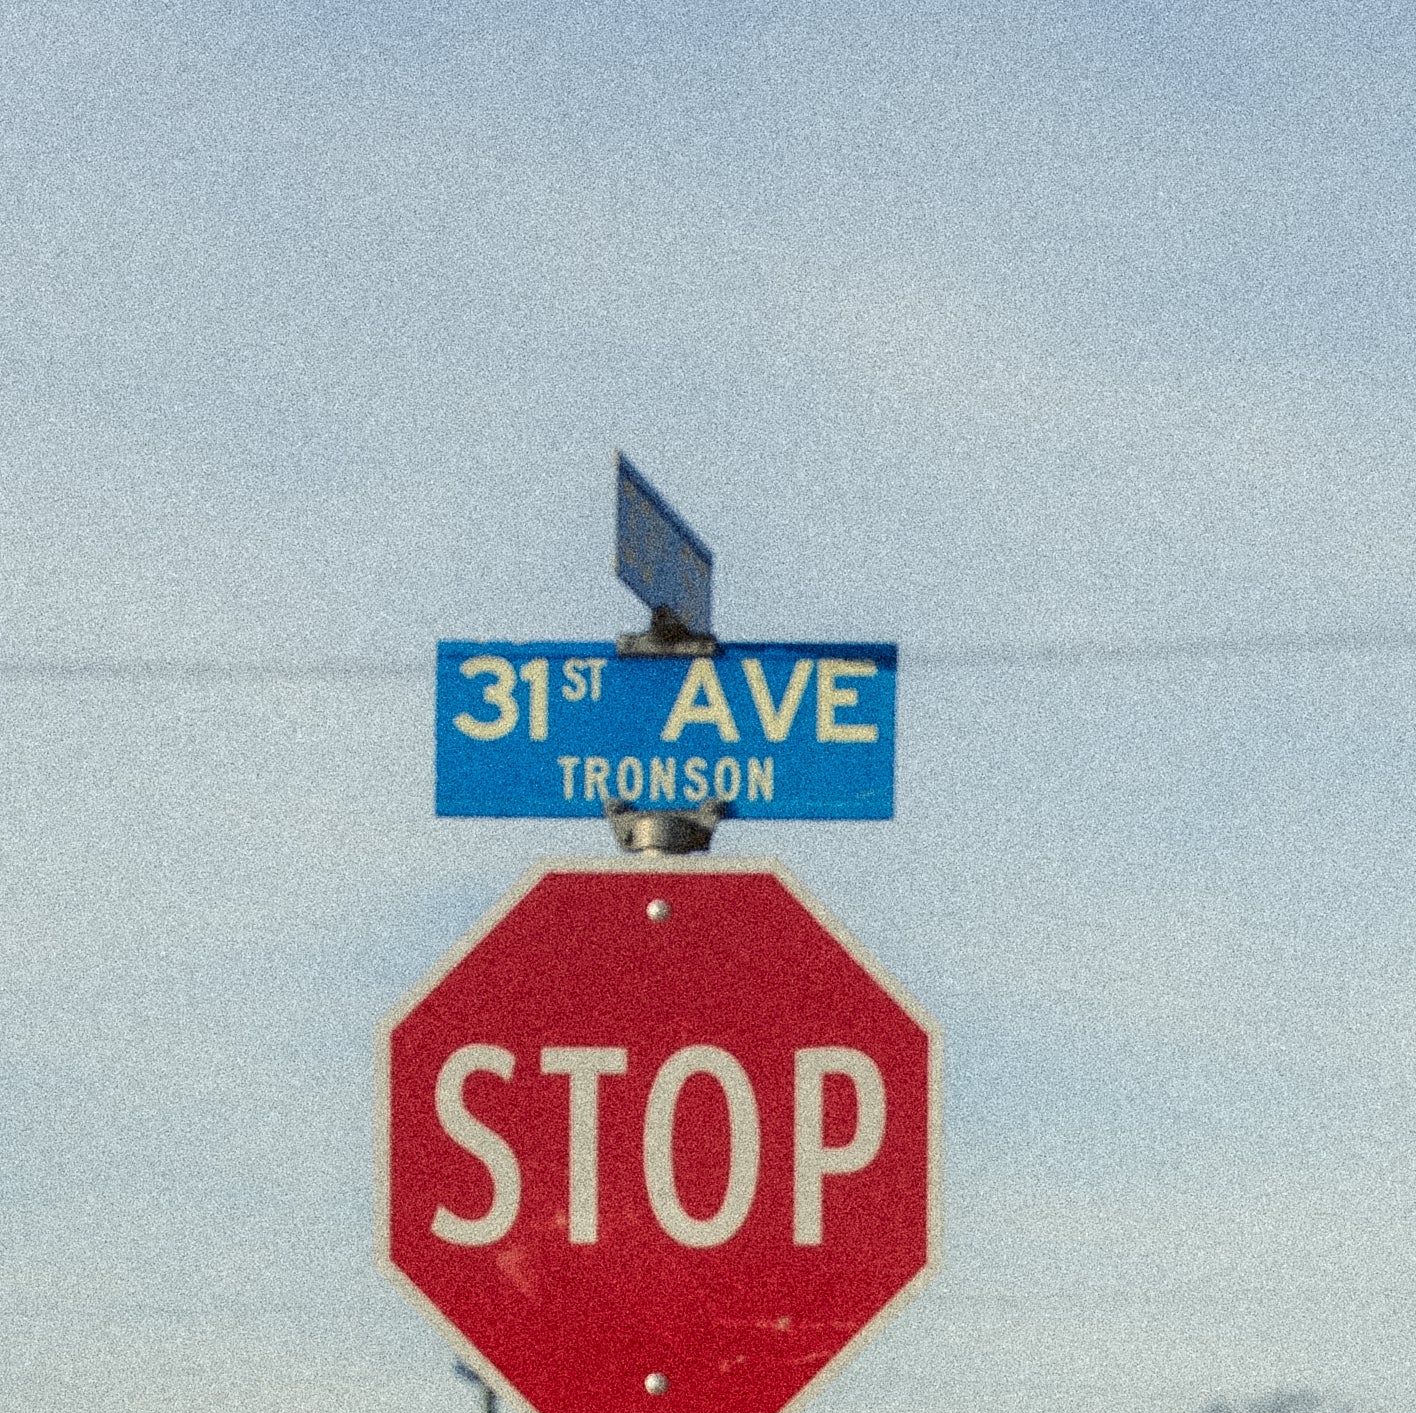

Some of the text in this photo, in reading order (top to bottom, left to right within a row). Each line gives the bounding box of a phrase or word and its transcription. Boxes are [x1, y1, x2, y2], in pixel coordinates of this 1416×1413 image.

[453, 656, 879, 743] 31ST AVE
[557, 756, 774, 801] TRONSON
[431, 1043, 887, 1247] STOP
